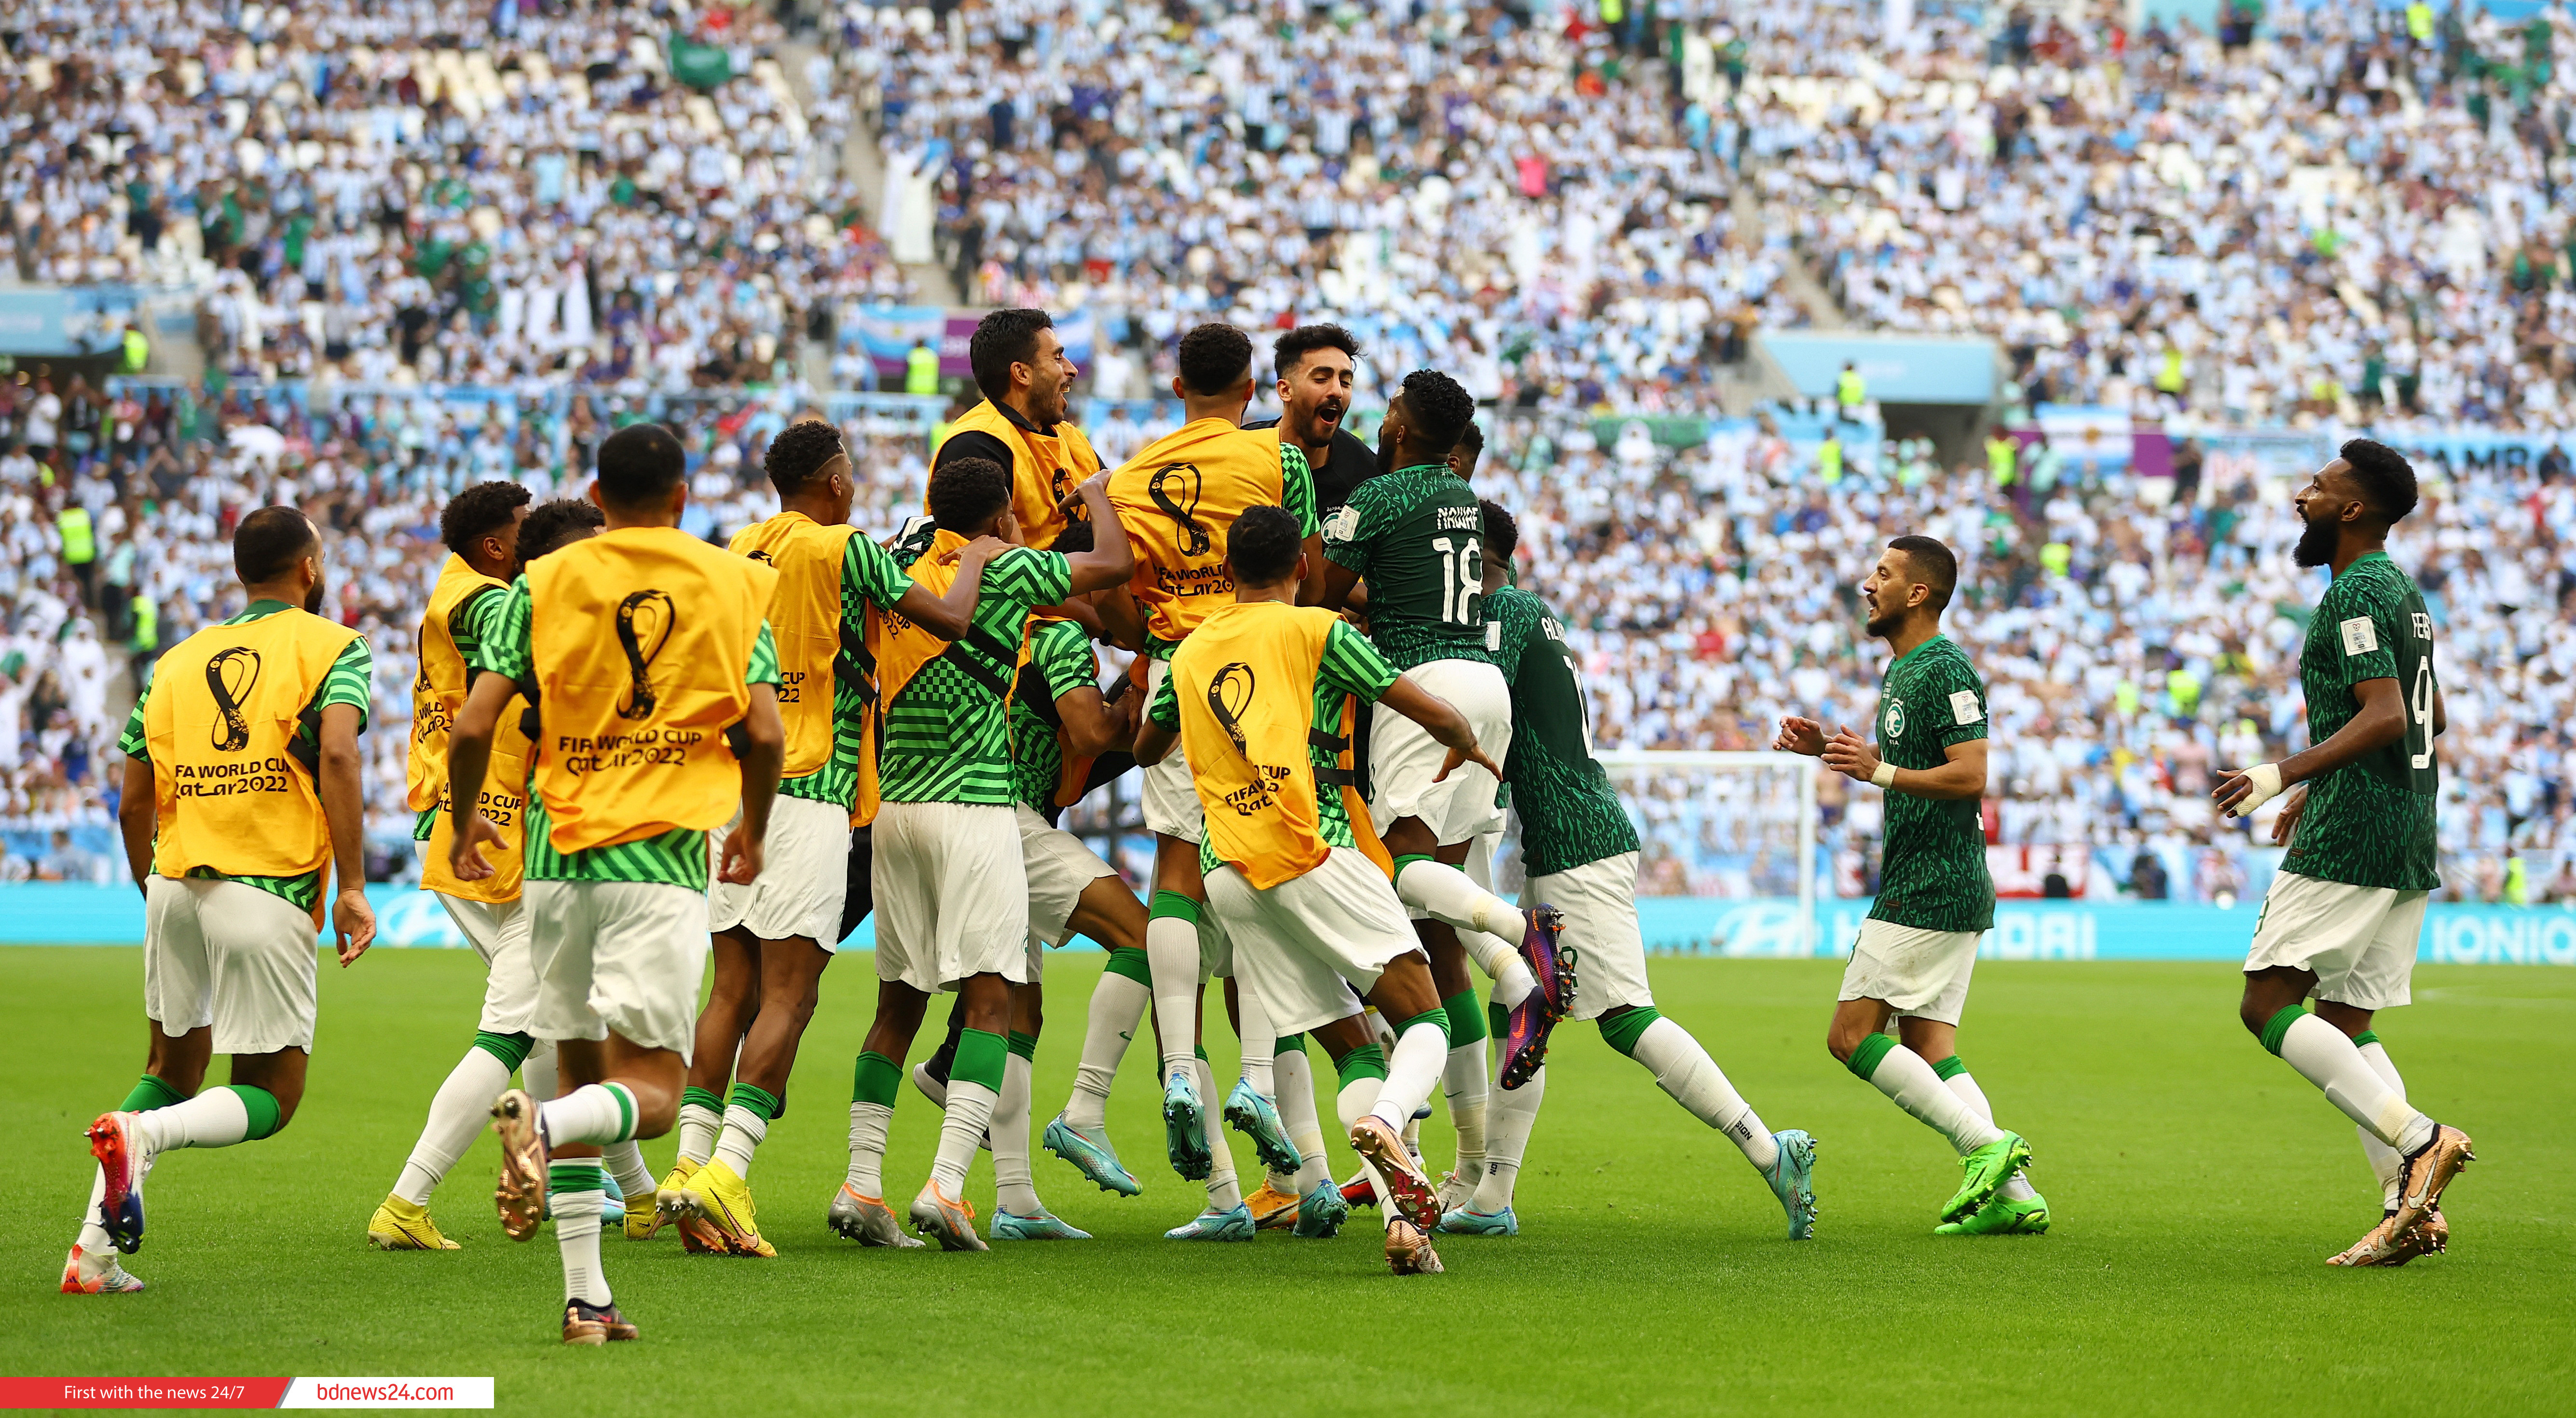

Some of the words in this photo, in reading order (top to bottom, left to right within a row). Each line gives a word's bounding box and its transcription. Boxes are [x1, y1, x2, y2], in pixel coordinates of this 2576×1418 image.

[1437, 507, 1479, 530] NAWAF
[1432, 537, 1483, 626] 18
[2412, 655, 2434, 769] 9
[664, 730, 702, 745] CUP
[198, 761, 261, 778] WORLD
[1225, 783, 1260, 807] FIFA
